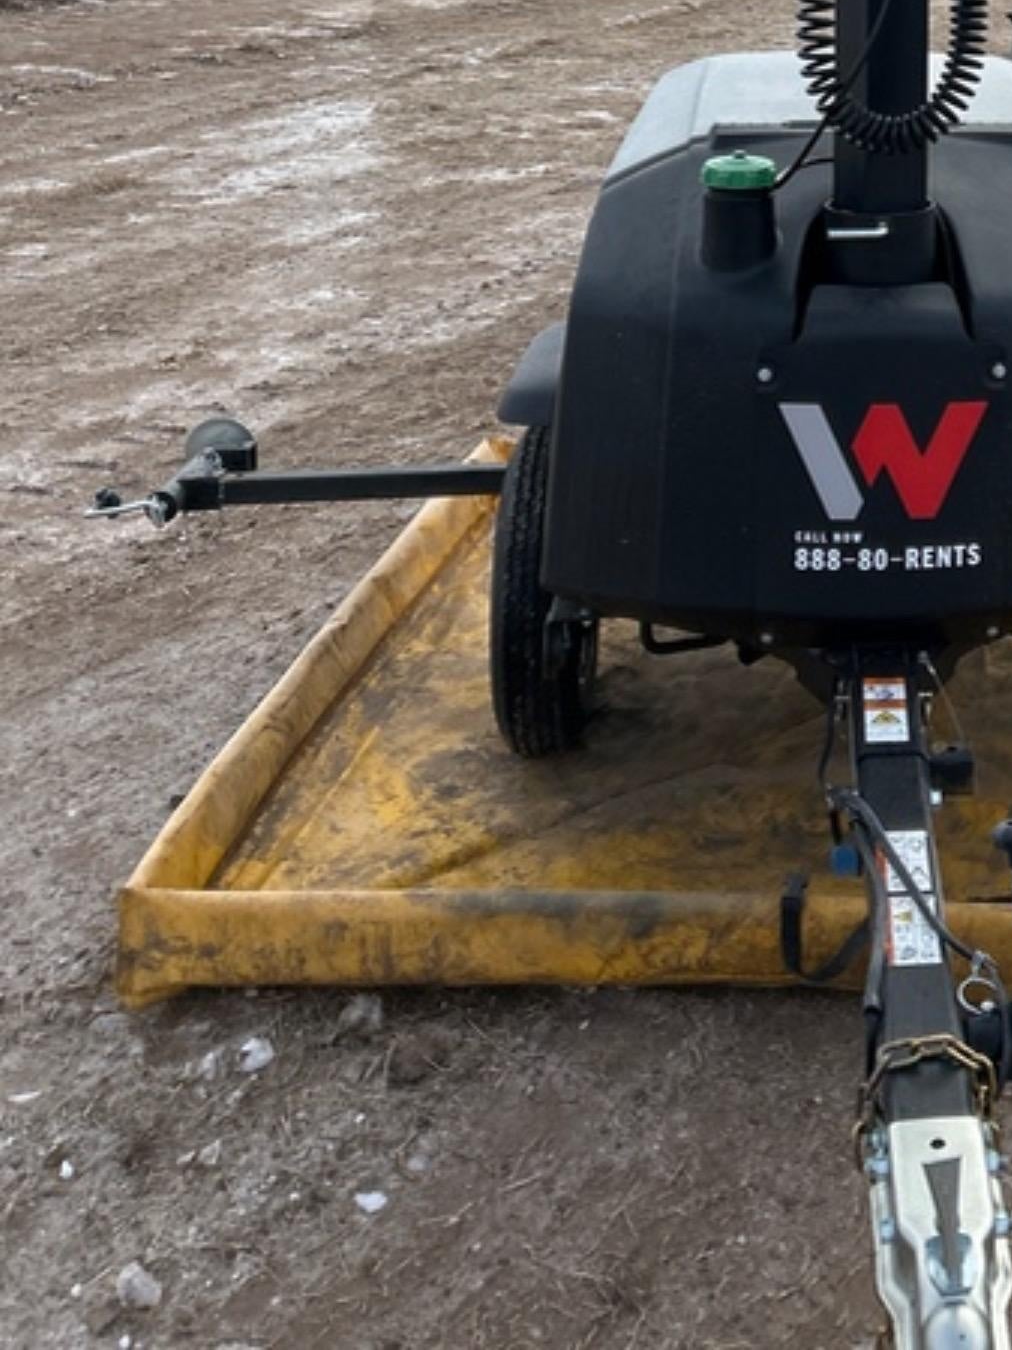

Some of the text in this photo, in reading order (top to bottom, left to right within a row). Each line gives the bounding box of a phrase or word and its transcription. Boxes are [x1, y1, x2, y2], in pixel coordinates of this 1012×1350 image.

[778, 401, 989, 521] W
[794, 530, 864, 544] CALL NOW
[793, 542, 983, 572] 888-80-RENTS
